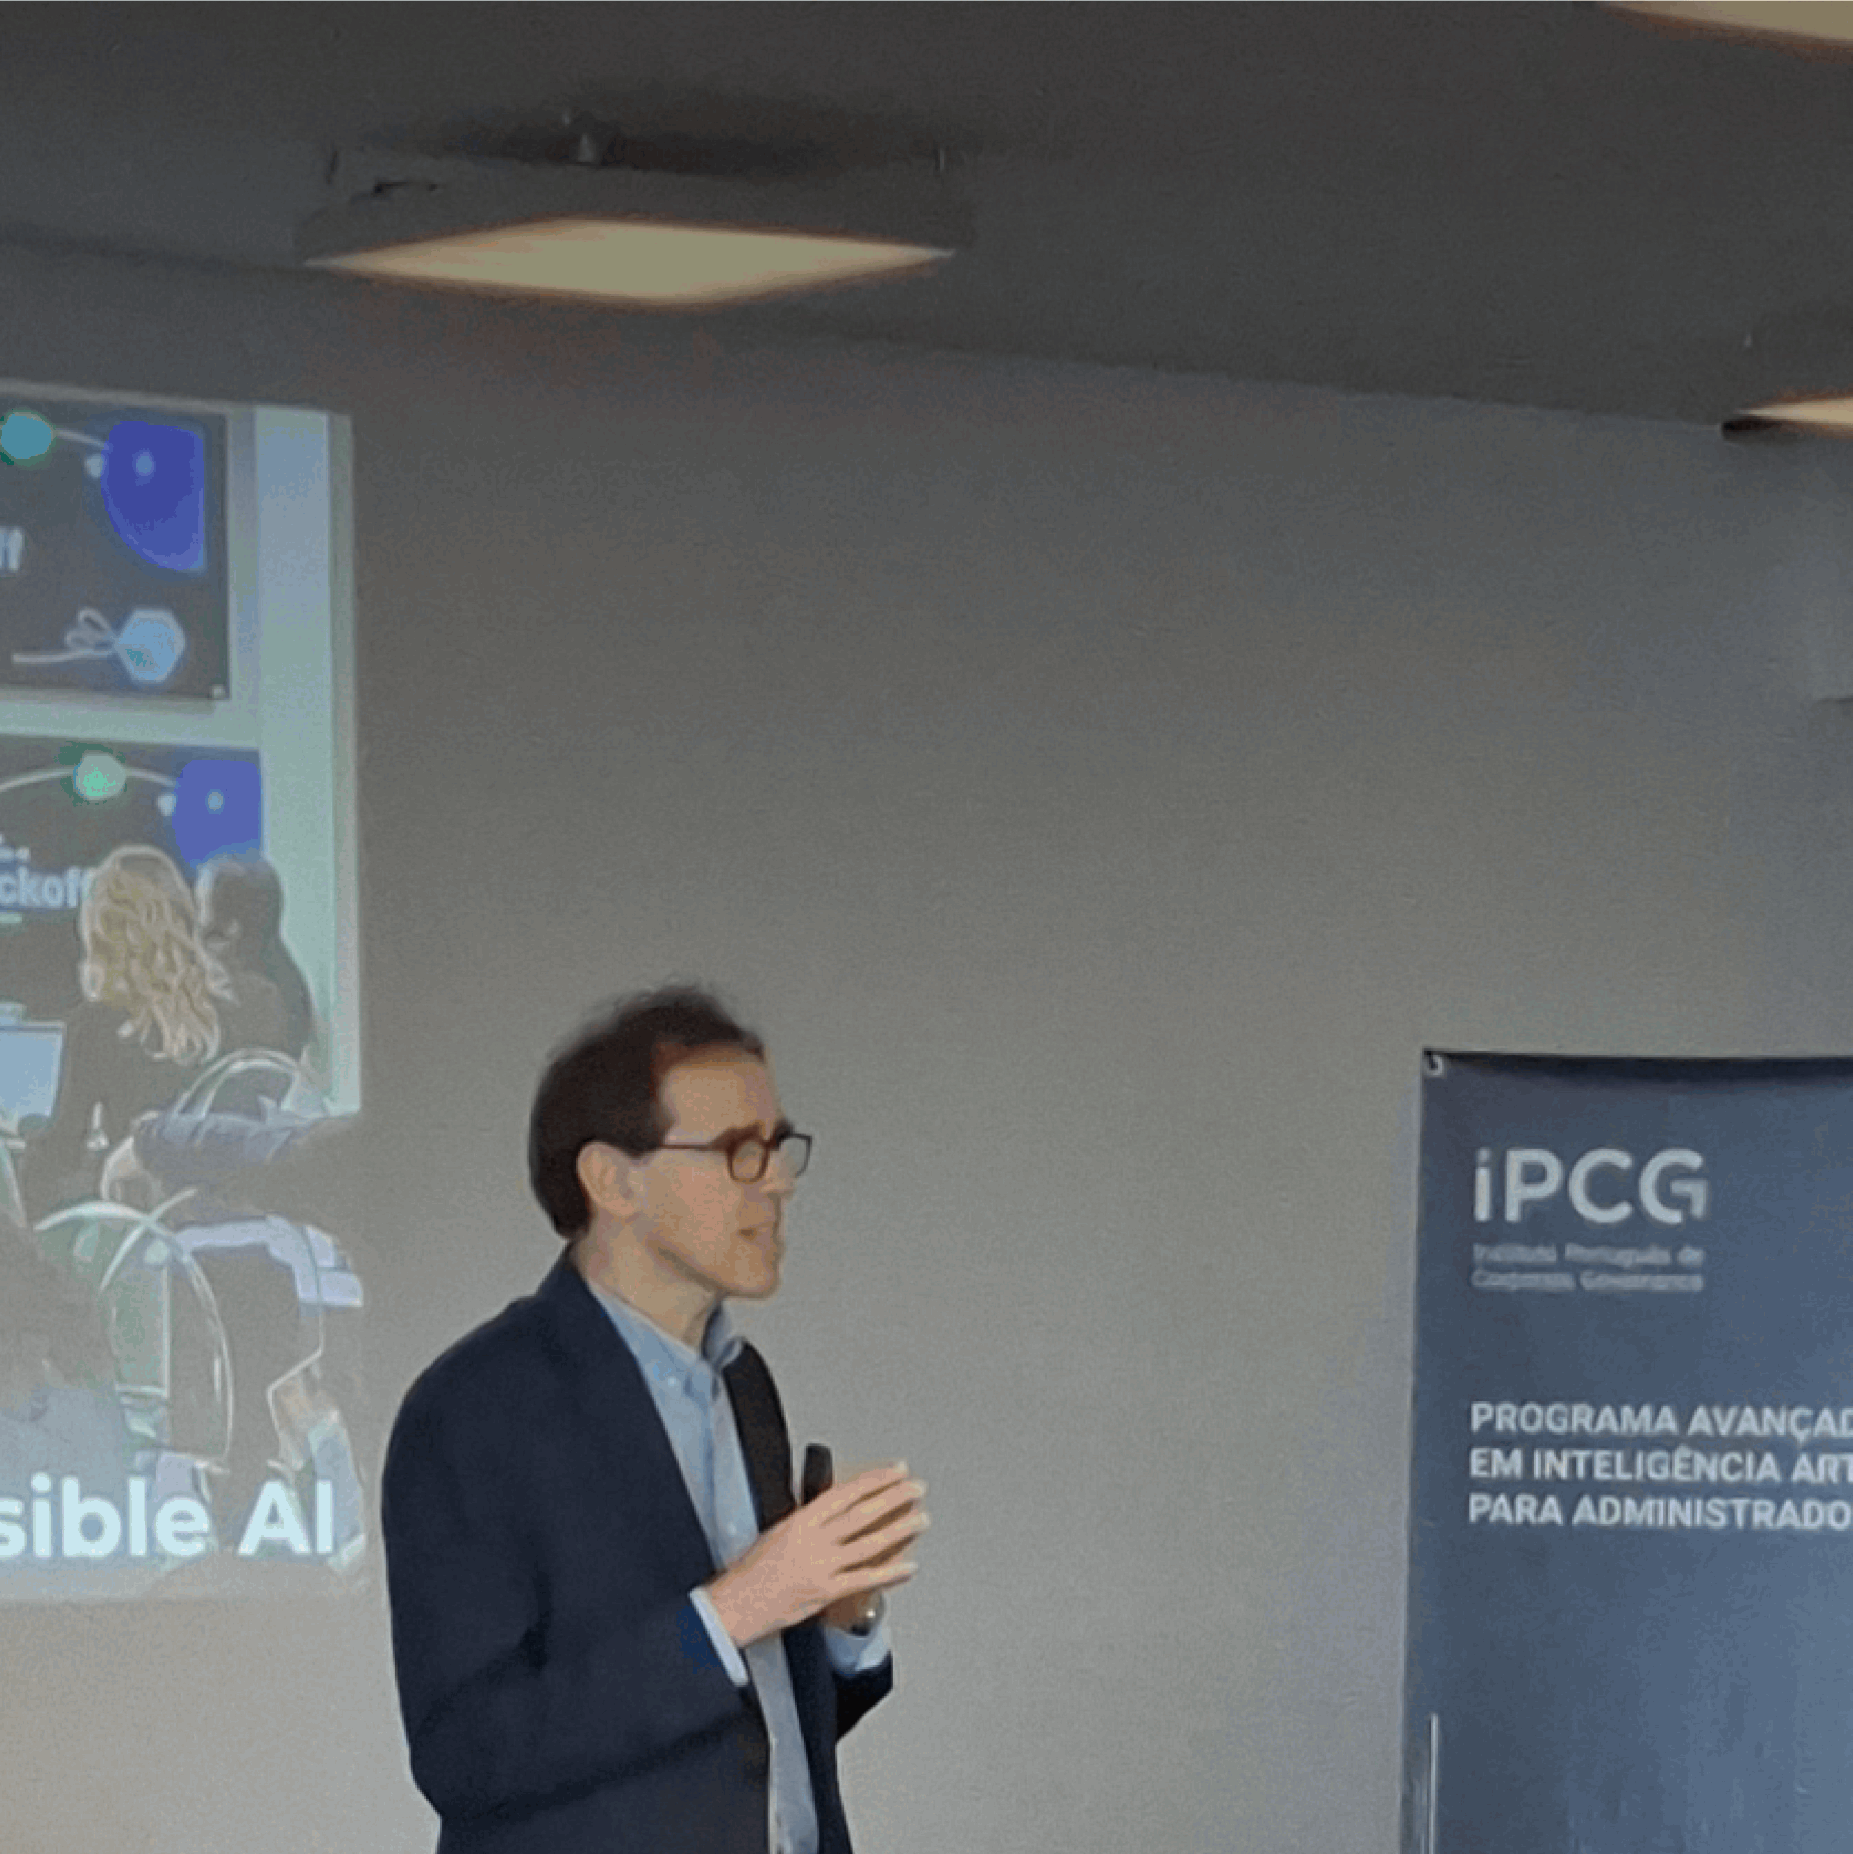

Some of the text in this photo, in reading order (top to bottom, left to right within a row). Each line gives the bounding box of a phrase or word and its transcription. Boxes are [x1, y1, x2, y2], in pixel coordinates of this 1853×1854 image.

[1474, 1149, 1708, 1225] iPCG
[1470, 1403, 1677, 1437] PROGRAMA
[1470, 1450, 1521, 1481] EM
[1533, 1446, 1780, 1485] INTELIGÊNCIA
[238, 1476, 335, 1557] AI
[1469, 1495, 1562, 1527] PARA
